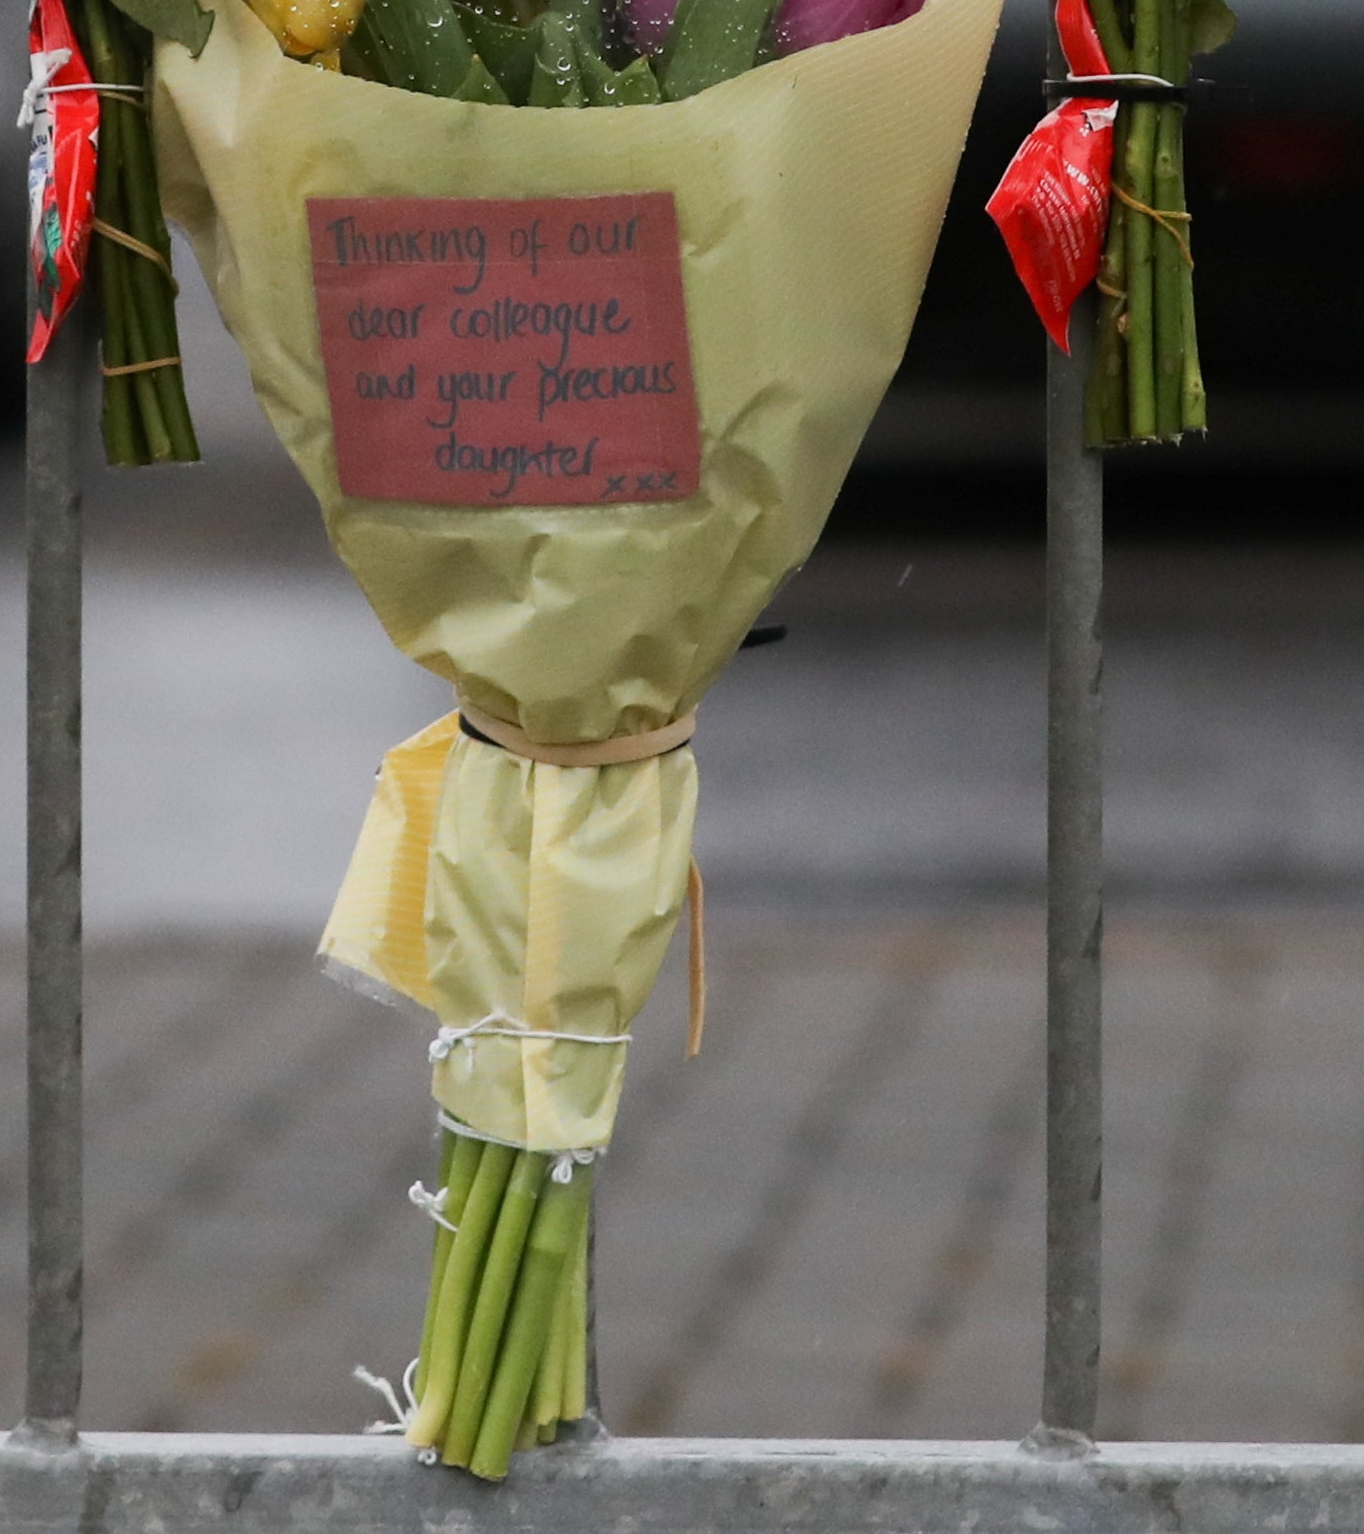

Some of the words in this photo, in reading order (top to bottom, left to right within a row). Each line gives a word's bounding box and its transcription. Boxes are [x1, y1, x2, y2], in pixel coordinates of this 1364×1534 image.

[326, 215, 487, 295] Thinking
[510, 218, 550, 277] of
[569, 215, 640, 256] our
[348, 301, 427, 341] dear
[449, 296, 632, 369] colleague
[355, 364, 417, 401] and
[427, 369, 517, 429] your
[538, 360, 677, 423] precious
[436, 431, 600, 500] daughter
